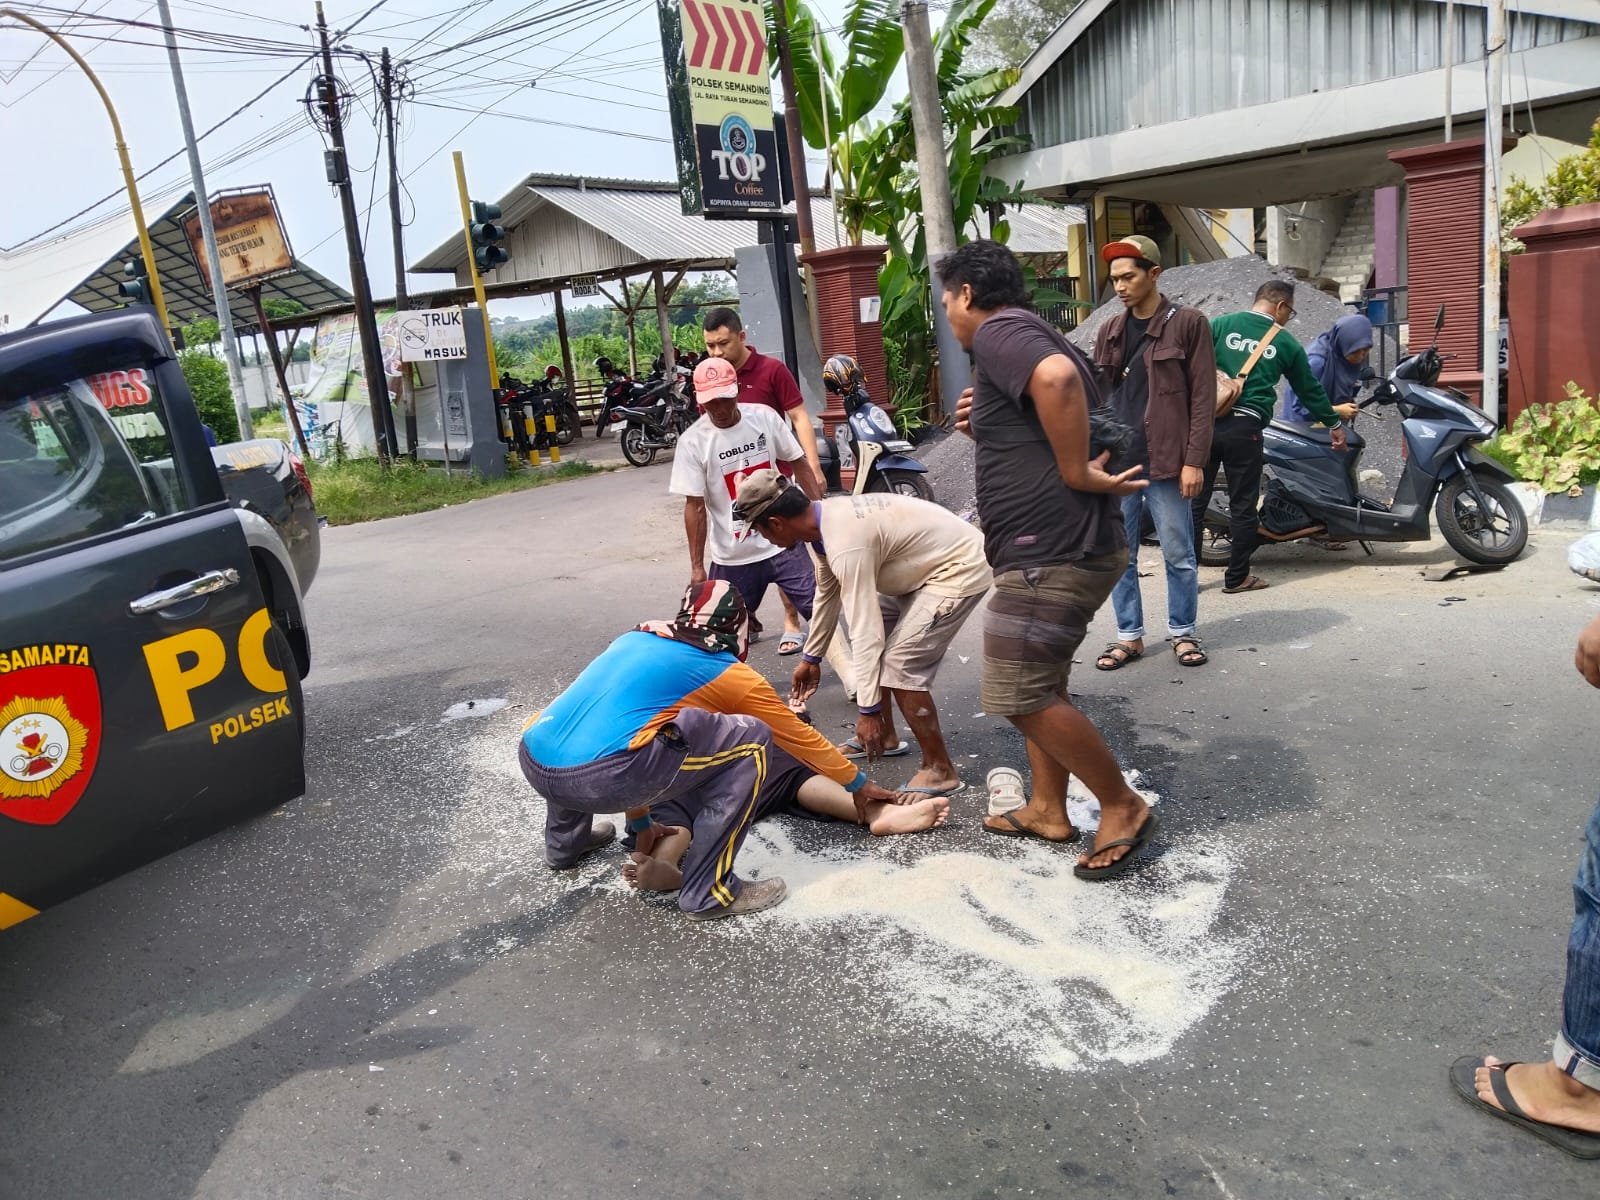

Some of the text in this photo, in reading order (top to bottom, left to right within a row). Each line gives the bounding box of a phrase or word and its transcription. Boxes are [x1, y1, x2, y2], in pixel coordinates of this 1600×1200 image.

[691, 77, 770, 95] POLSEK SEMANDING
[720, 95, 738, 103] TUBAN
[711, 149, 767, 182] TOP
[734, 182, 764, 196] Coffee
[709, 199, 776, 208] KOPINYA ORANG INDONESIA
[575, 286, 592, 296] RODA
[421, 312, 462, 327] TRUK
[424, 346, 466, 358] MASUK
[719, 442, 756, 460] COBLOS
[744, 459, 750, 467] 3
[0, 644, 89, 674] SAMAPTA
[209, 695, 291, 744] POLSEK
